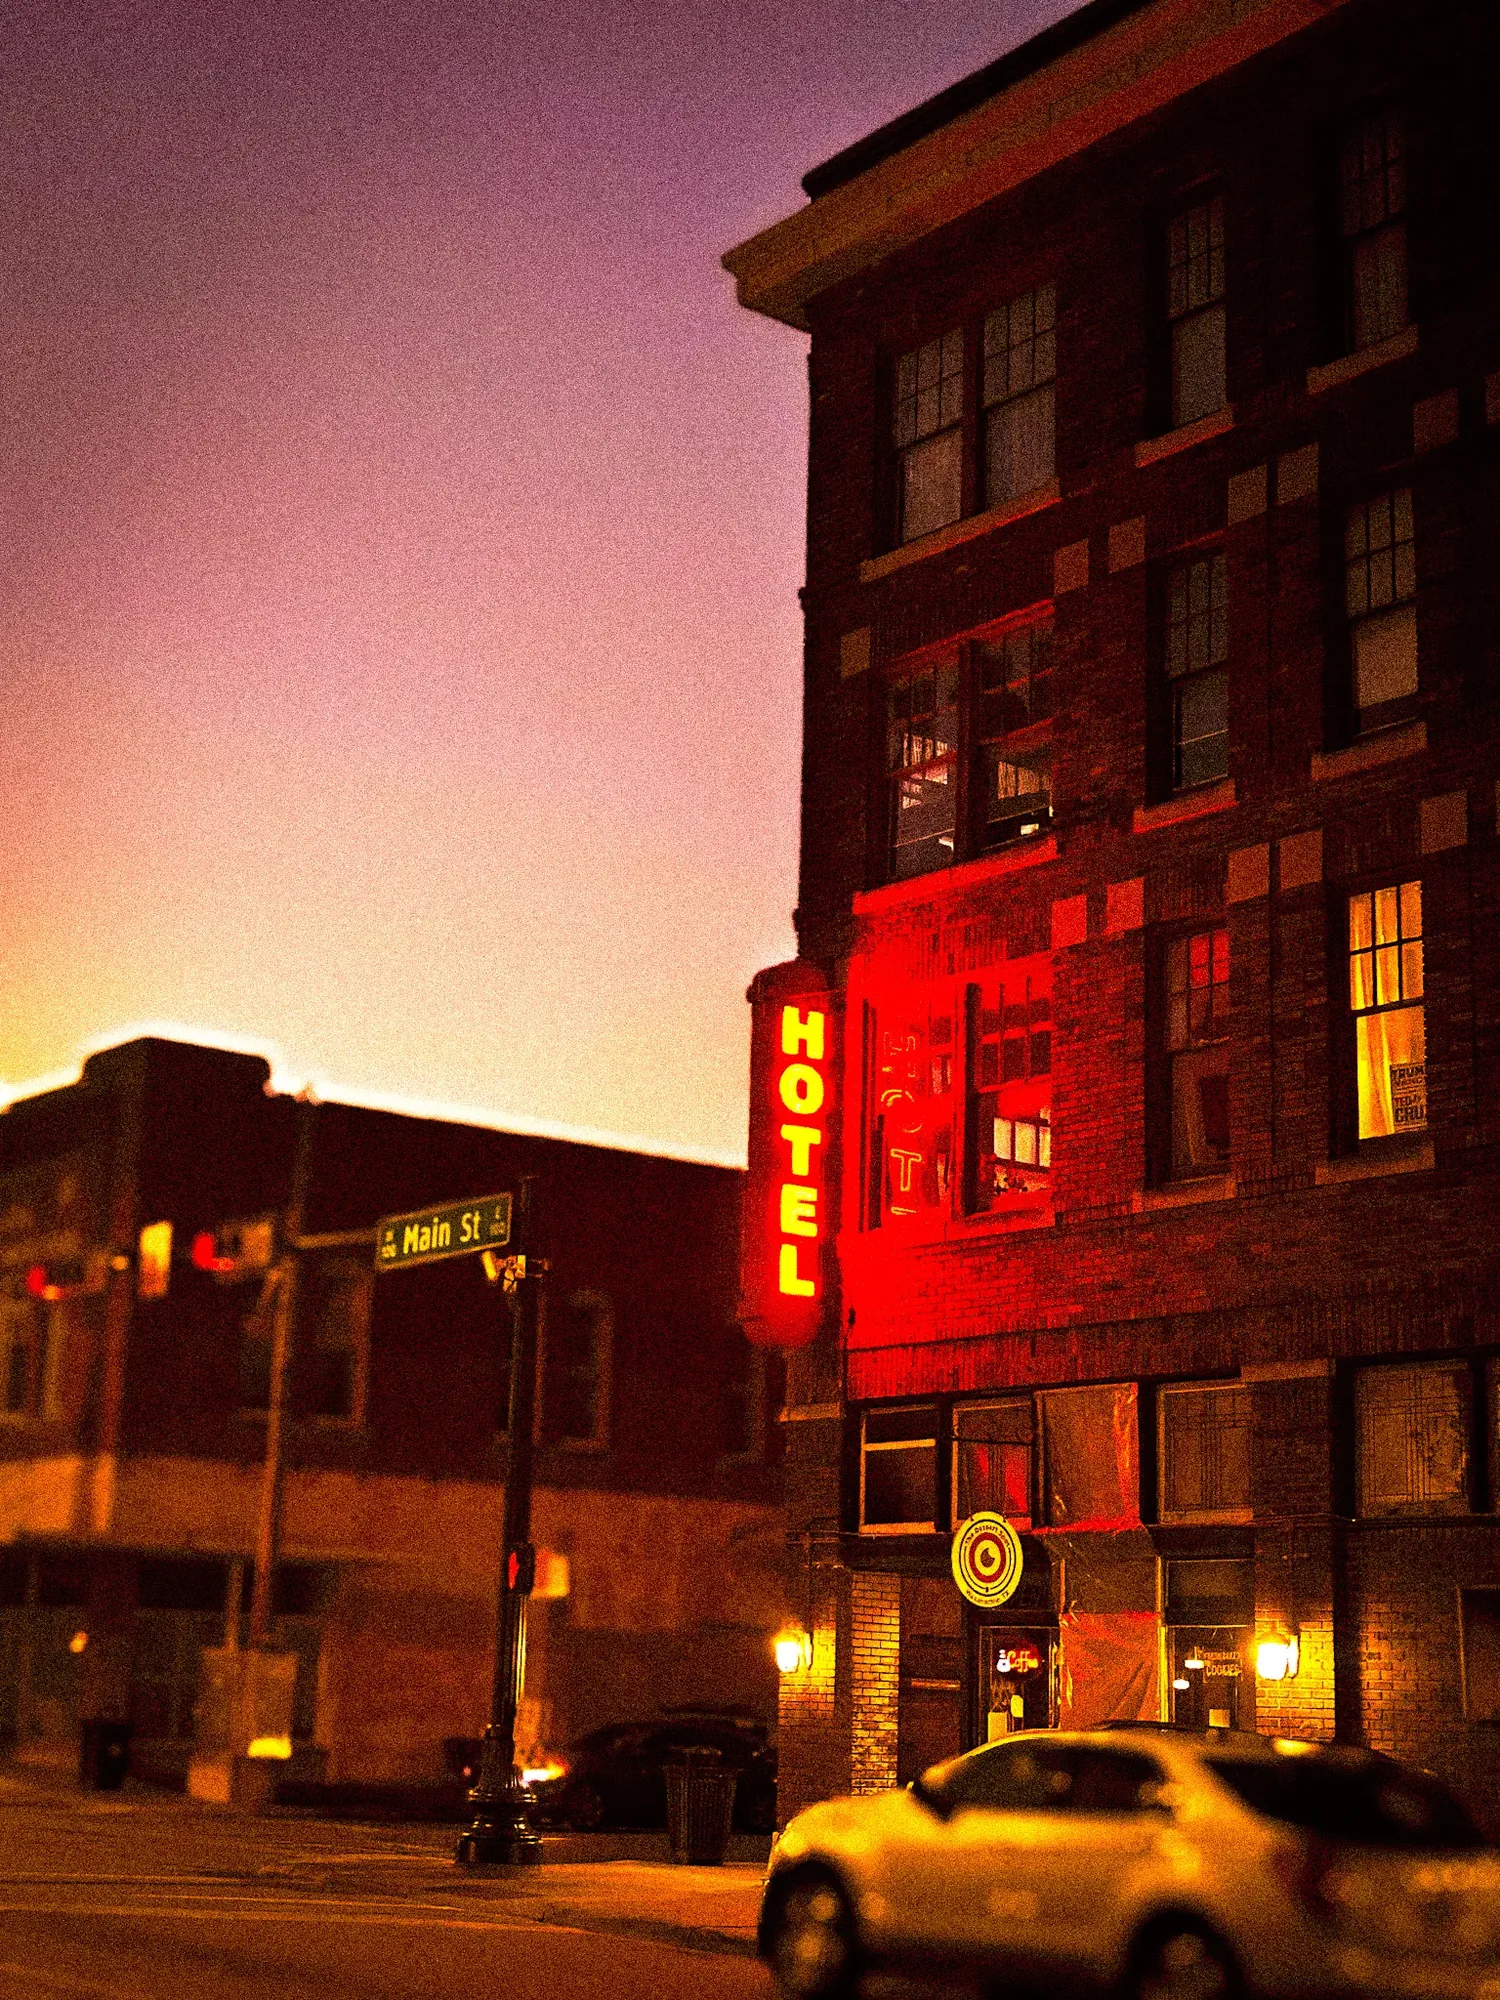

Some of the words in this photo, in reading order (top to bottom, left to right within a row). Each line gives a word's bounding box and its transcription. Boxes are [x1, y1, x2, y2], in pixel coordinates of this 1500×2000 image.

[403, 1217, 450, 1254] Main
[460, 1210, 480, 1242] St
[779, 1005, 824, 1297] HOTEL
